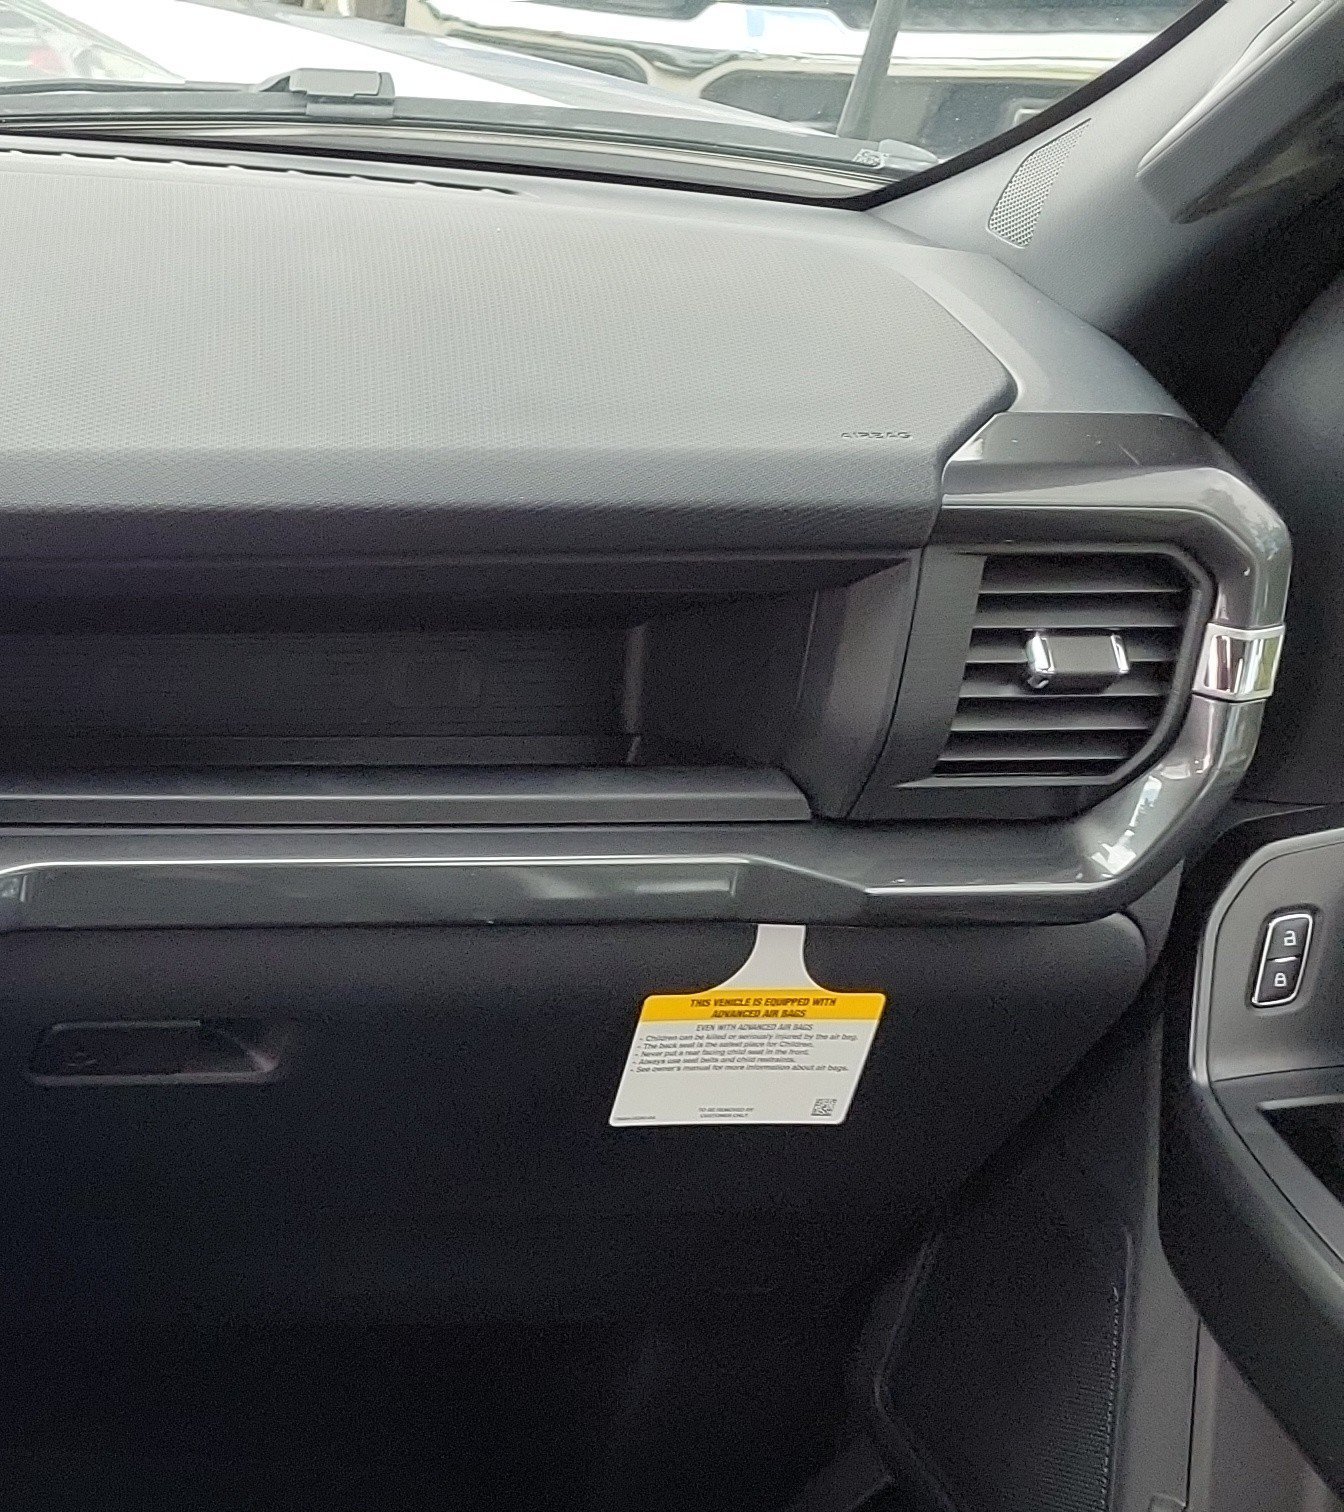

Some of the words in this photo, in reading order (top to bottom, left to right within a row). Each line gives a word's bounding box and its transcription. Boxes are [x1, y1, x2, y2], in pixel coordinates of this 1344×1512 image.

[691, 999, 711, 1007] THIS
[714, 998, 751, 1006] VEHICLE
[753, 998, 762, 1006] IS
[764, 998, 810, 1006] EQUIPPED
[812, 998, 836, 1006] WITH
[711, 1010, 760, 1018] ADVANCED
